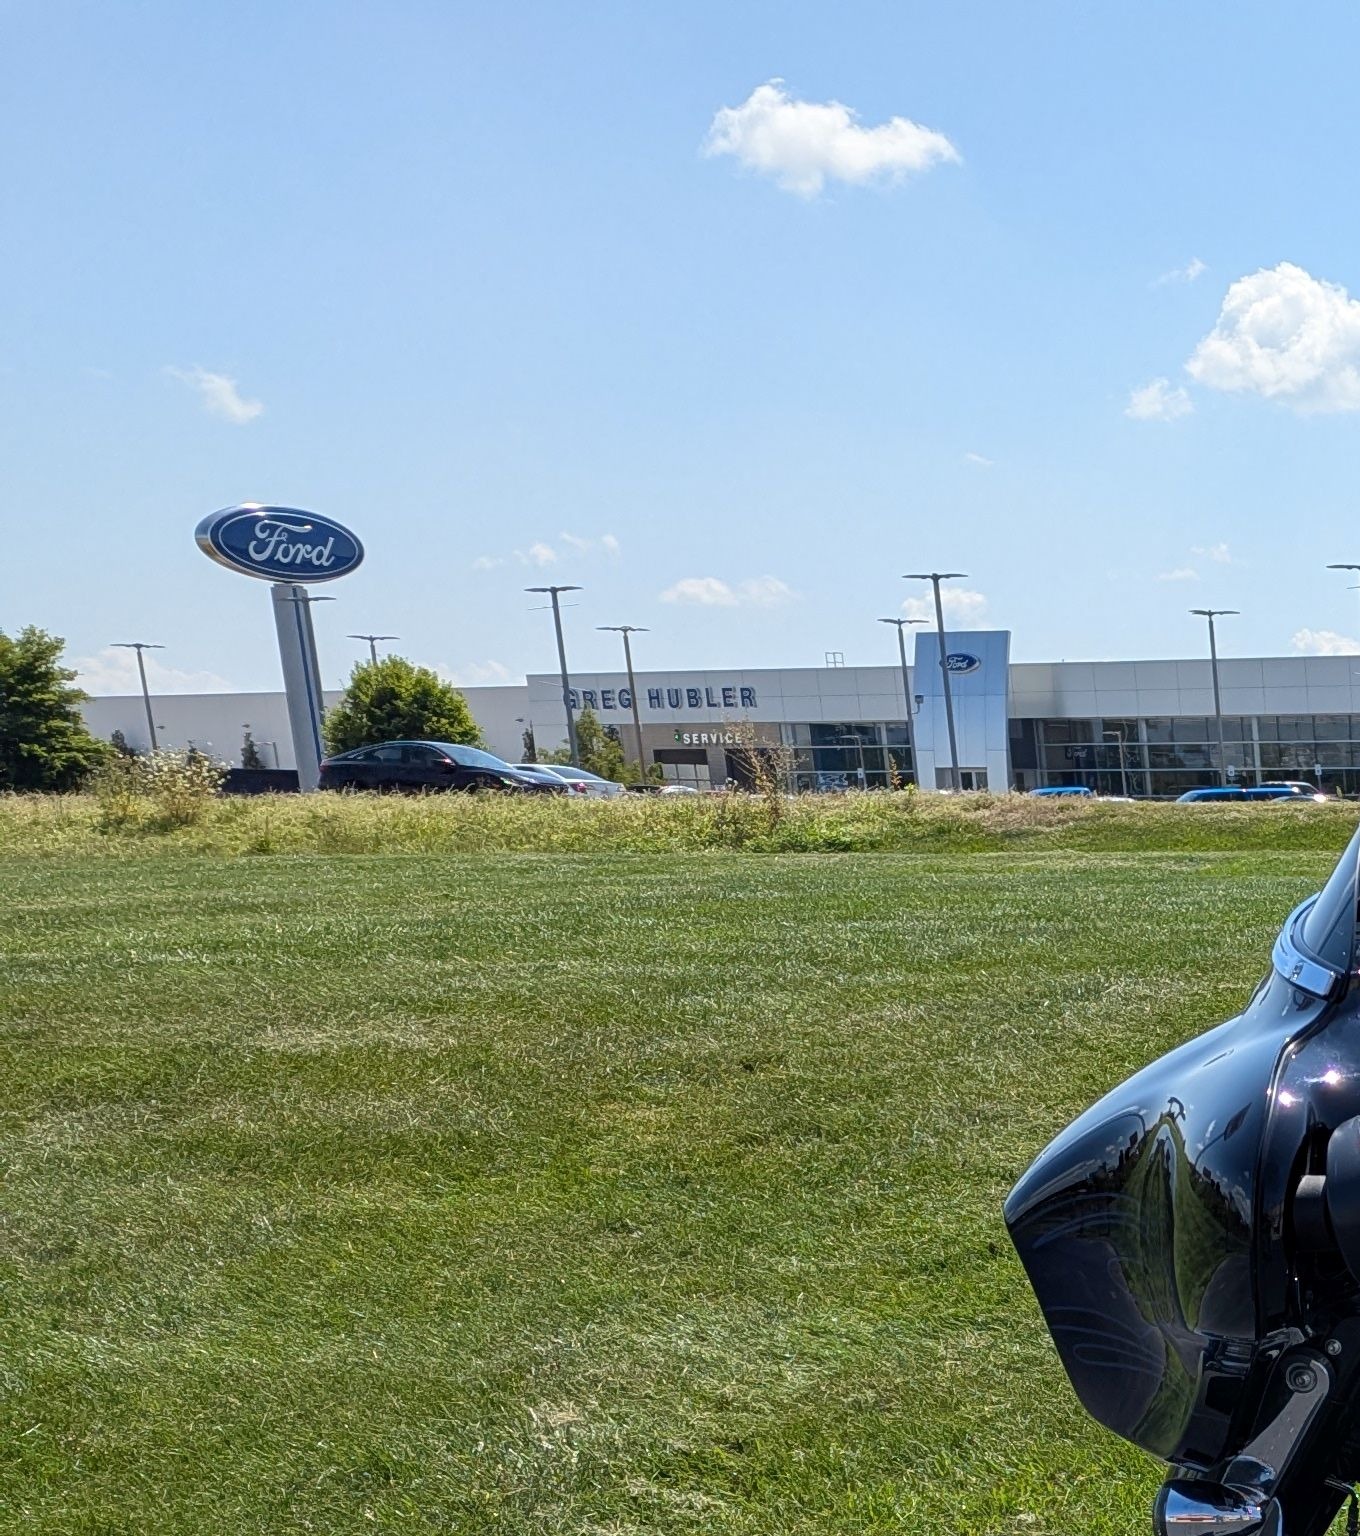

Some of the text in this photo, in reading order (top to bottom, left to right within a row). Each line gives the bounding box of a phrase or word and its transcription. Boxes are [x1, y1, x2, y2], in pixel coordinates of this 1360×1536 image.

[248, 519, 337, 567] Ford
[563, 686, 757, 710] GREG HUBLER
[682, 732, 742, 745] SERVICE
